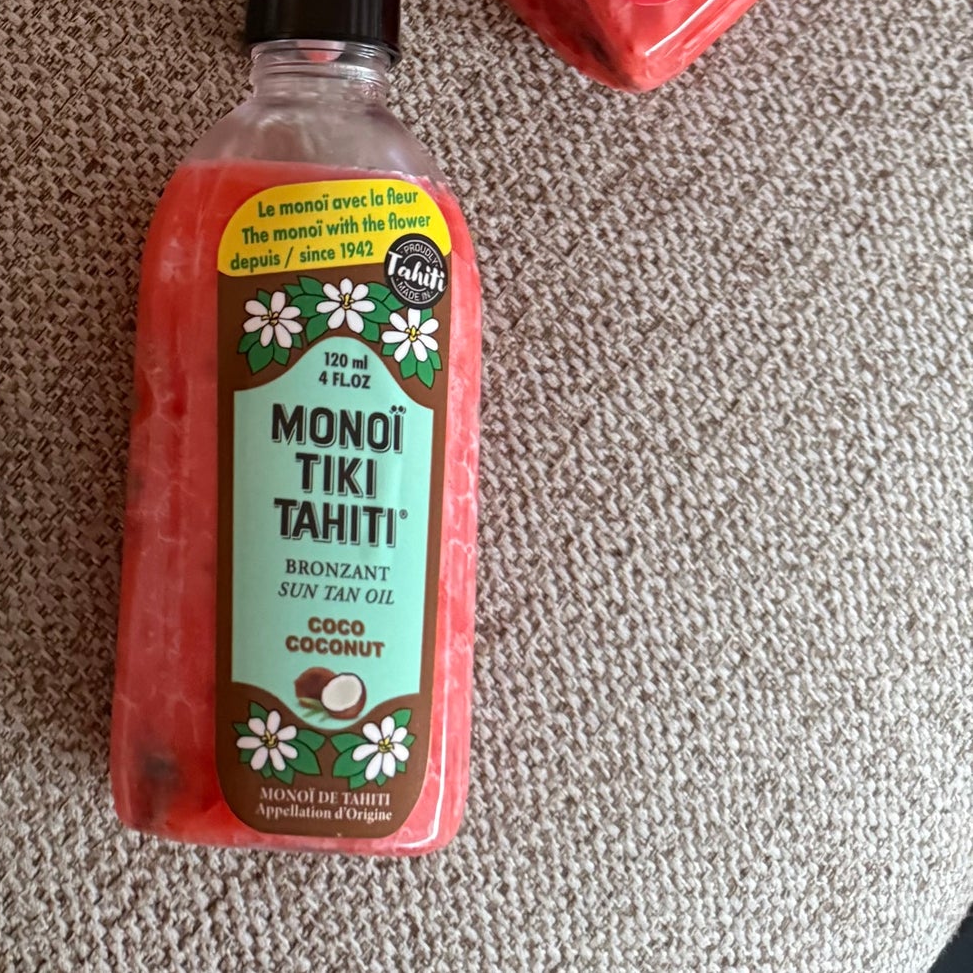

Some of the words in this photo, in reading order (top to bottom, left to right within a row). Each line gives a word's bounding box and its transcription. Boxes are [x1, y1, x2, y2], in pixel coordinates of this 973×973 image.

[258, 201, 275, 219] Le
[279, 194, 329, 216] monoï
[332, 194, 368, 211] avec
[370, 189, 384, 206] la
[386, 187, 418, 206] fleur
[241, 227, 269, 246] The
[273, 219, 323, 242] monoï
[326, 219, 360, 236] with
[362, 216, 386, 232] the
[387, 212, 432, 230] flower
[230, 250, 281, 273] depuis
[299, 246, 336, 263] since
[340, 241, 374, 259] 1942
[404, 244, 439, 264] PROUDLY
[388, 251, 447, 292] Tahiti
[397, 282, 420, 301] MADE
[324, 352, 349, 369] 120
[351, 353, 368, 370] ml
[318, 371, 329, 386] 4
[332, 372, 372, 389] FL.OZ
[271, 403, 406, 454] MONOÏ
[295, 452, 377, 499] TIKI
[285, 558, 390, 581] BRONZANT
[278, 581, 318, 599] SUN
[325, 585, 361, 603] TAN
[365, 589, 395, 605] OIL
[307, 616, 365, 636] COCO
[285, 635, 385, 658] COCONUT
[259, 786, 314, 804] MONOÏ
[318, 791, 339, 805] DE
[342, 792, 391, 806] TAHITI
[255, 803, 334, 820] Appellation
[334, 806, 393, 823] d'Origine
